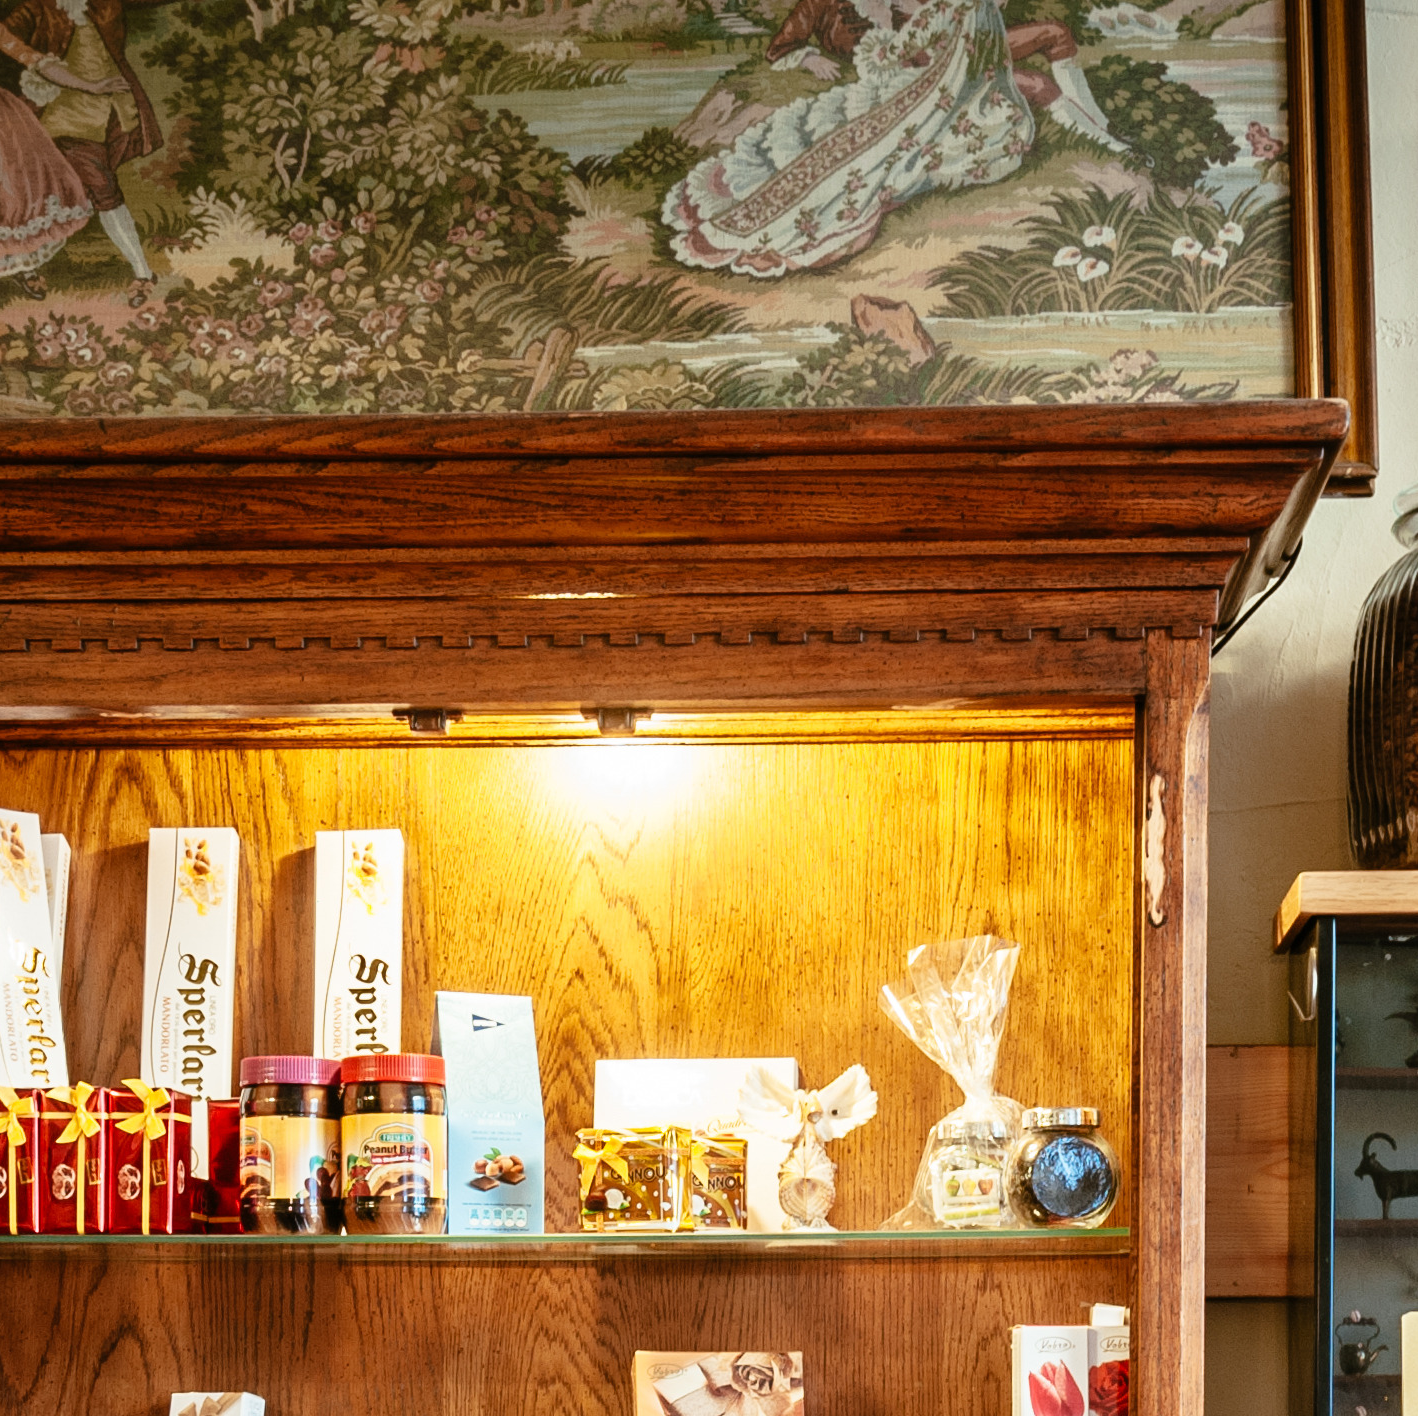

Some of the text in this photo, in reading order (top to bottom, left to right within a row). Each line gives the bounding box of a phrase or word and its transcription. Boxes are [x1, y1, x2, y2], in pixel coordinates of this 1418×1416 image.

[2, 981, 19, 1062] MANDORLATO
[17, 943, 56, 1085] Sperlar
[161, 995, 170, 1074] MANDORLATO
[175, 942, 223, 1101] Sperlari
[333, 995, 342, 1058] MANDORLA
[347, 943, 392, 1054] Sperl
[364, 1143, 398, 1155] Peanut
